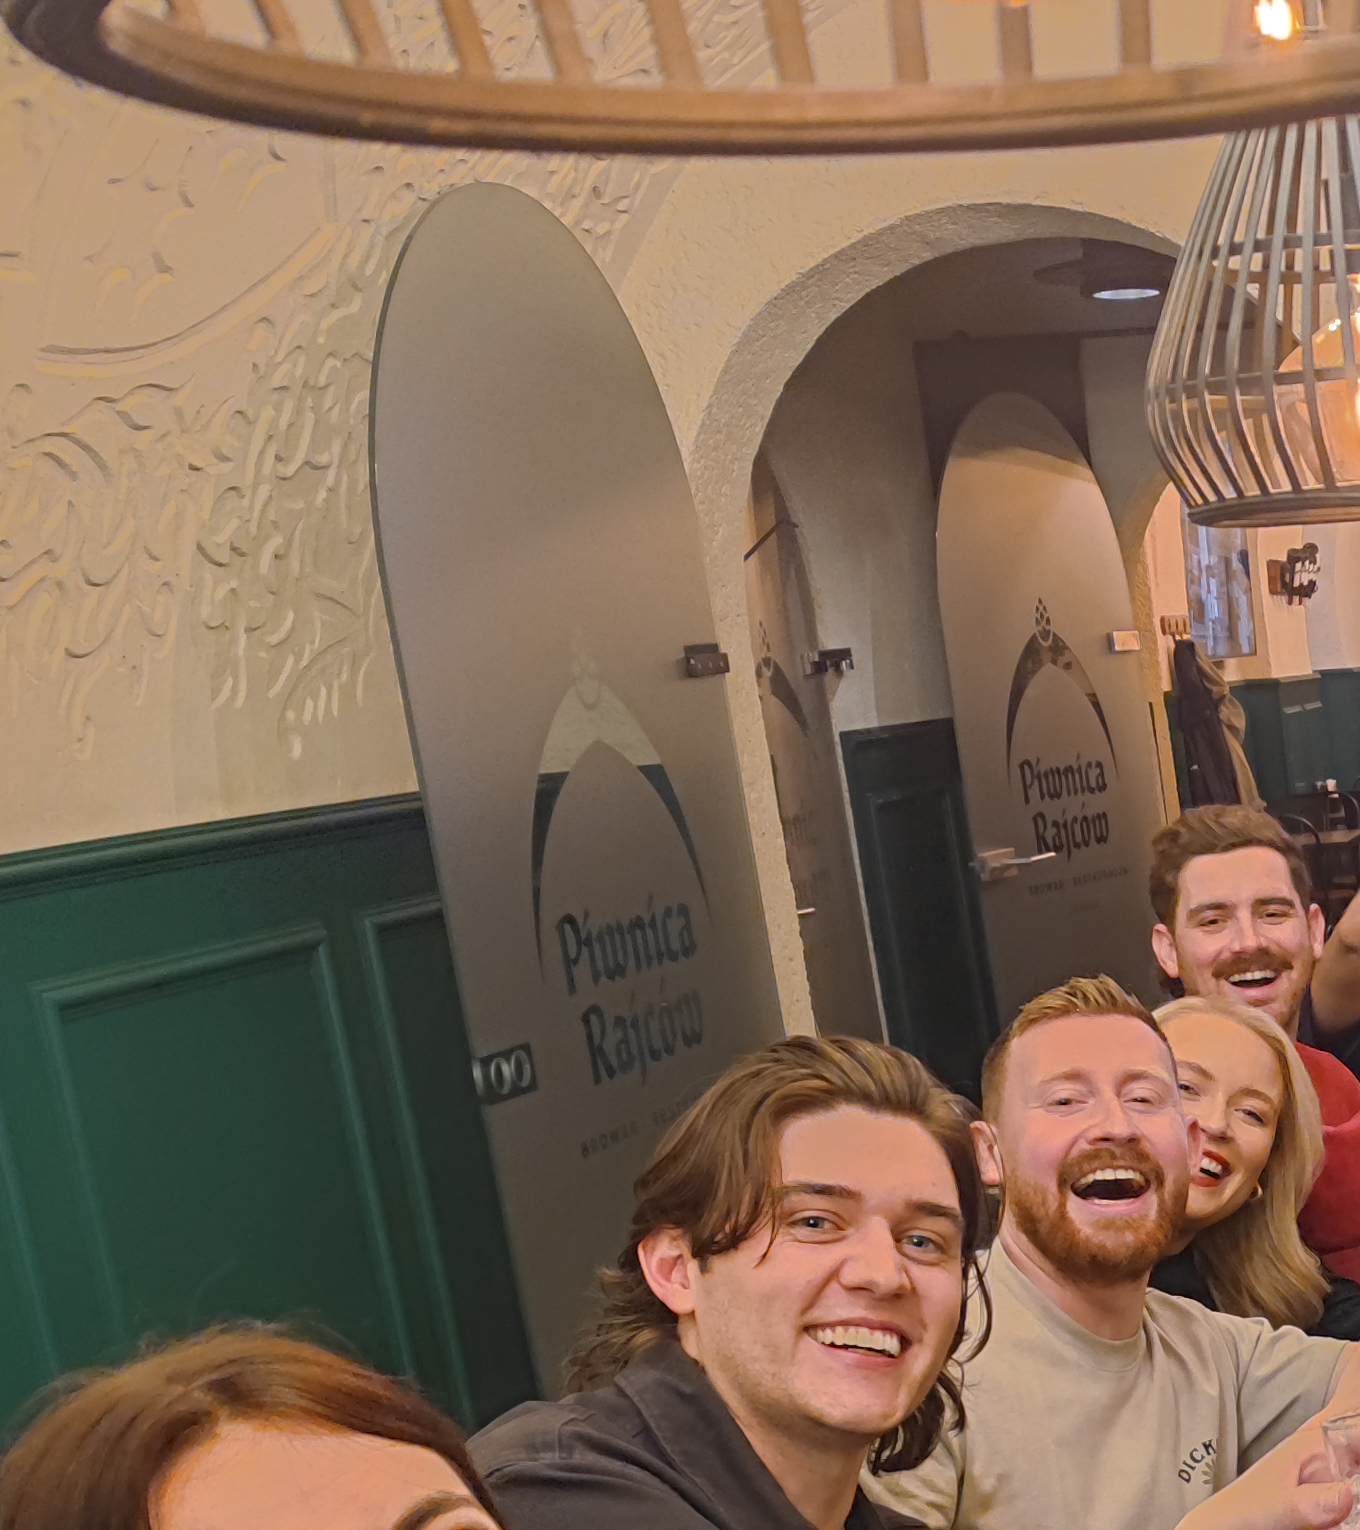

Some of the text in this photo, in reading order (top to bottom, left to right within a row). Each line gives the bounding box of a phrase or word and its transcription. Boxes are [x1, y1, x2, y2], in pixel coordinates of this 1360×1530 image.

[1018, 752, 1108, 806] Piwnica
[1032, 801, 1110, 862] Rajców
[555, 894, 697, 997] Piwnica
[581, 976, 703, 1086] Rajców
[1178, 1439, 1217, 1484] DICK
